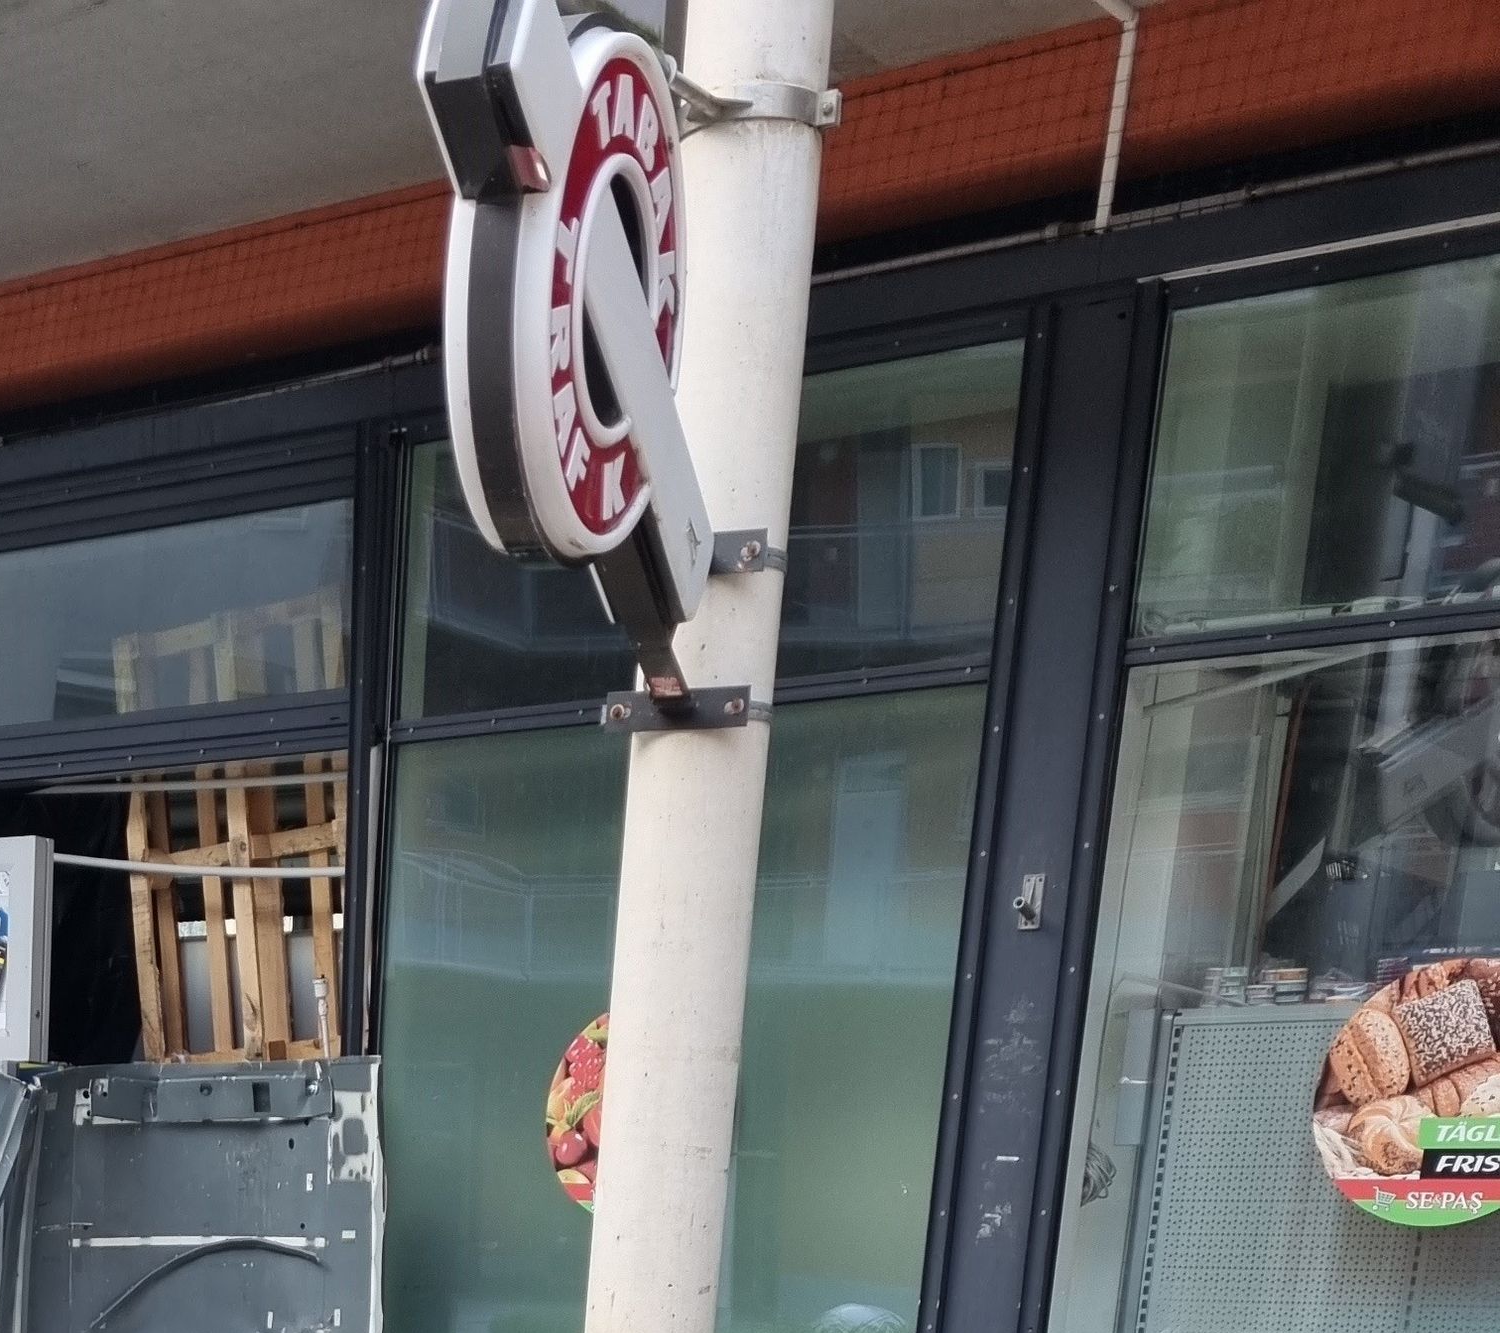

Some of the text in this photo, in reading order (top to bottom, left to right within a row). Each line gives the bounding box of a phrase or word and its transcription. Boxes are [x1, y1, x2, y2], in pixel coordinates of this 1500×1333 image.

[592, 73, 676, 318] TABAK
[550, 216, 627, 521] TRAFK
[1435, 1155, 1500, 1173] FRIS
[1436, 1120, 1500, 1142] TÄGL
